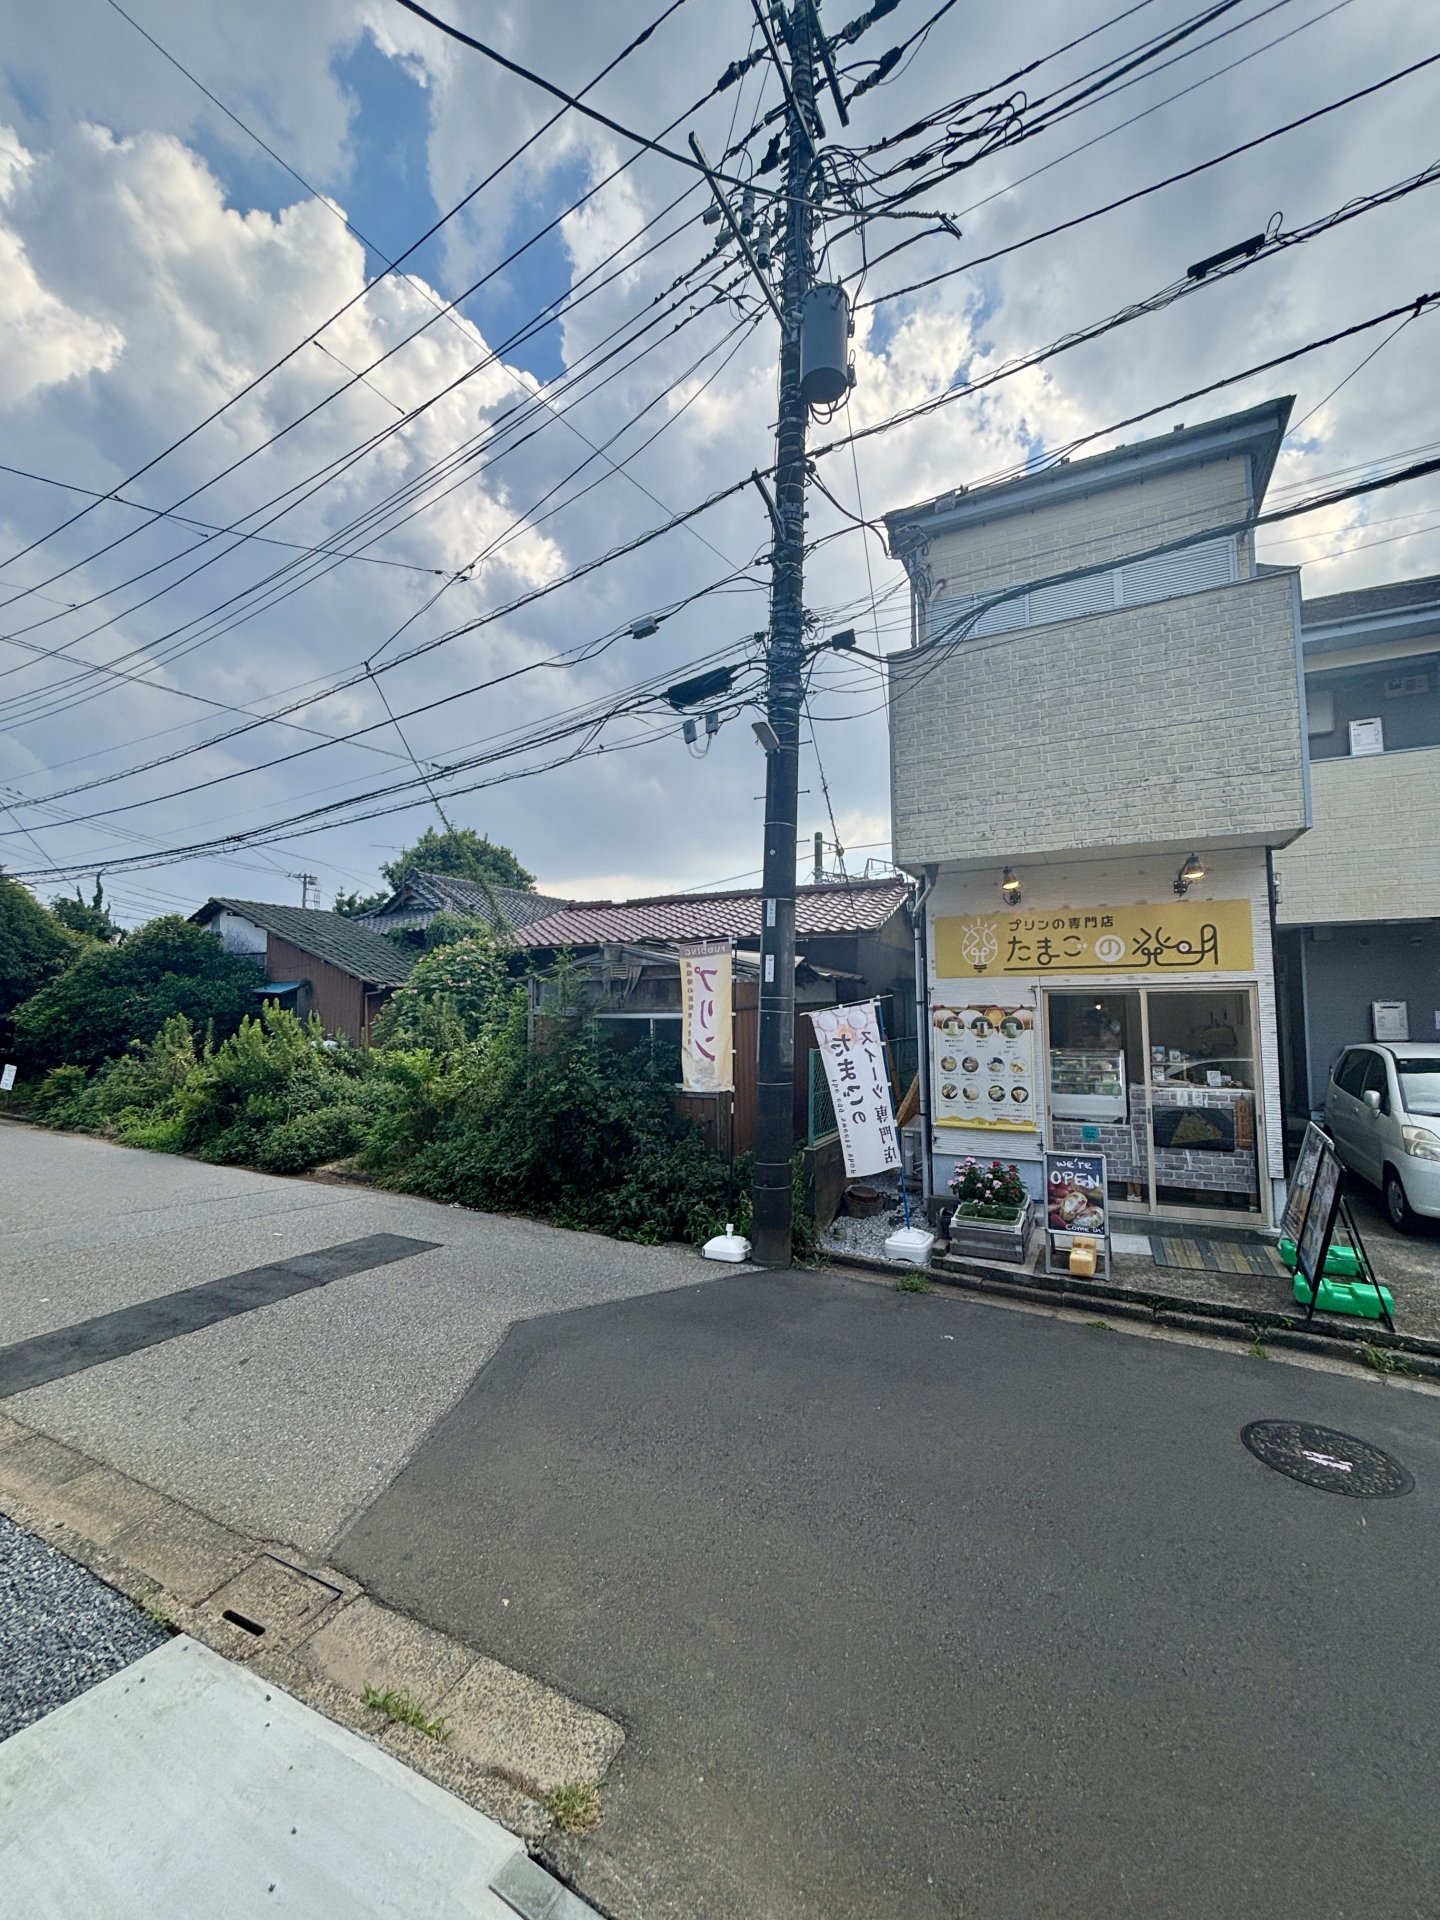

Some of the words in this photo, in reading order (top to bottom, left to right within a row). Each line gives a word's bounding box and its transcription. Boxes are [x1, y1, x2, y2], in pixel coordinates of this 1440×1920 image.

[1008, 915, 1114, 932] プリンの専門店
[1050, 1170, 1100, 1188] OPEN
